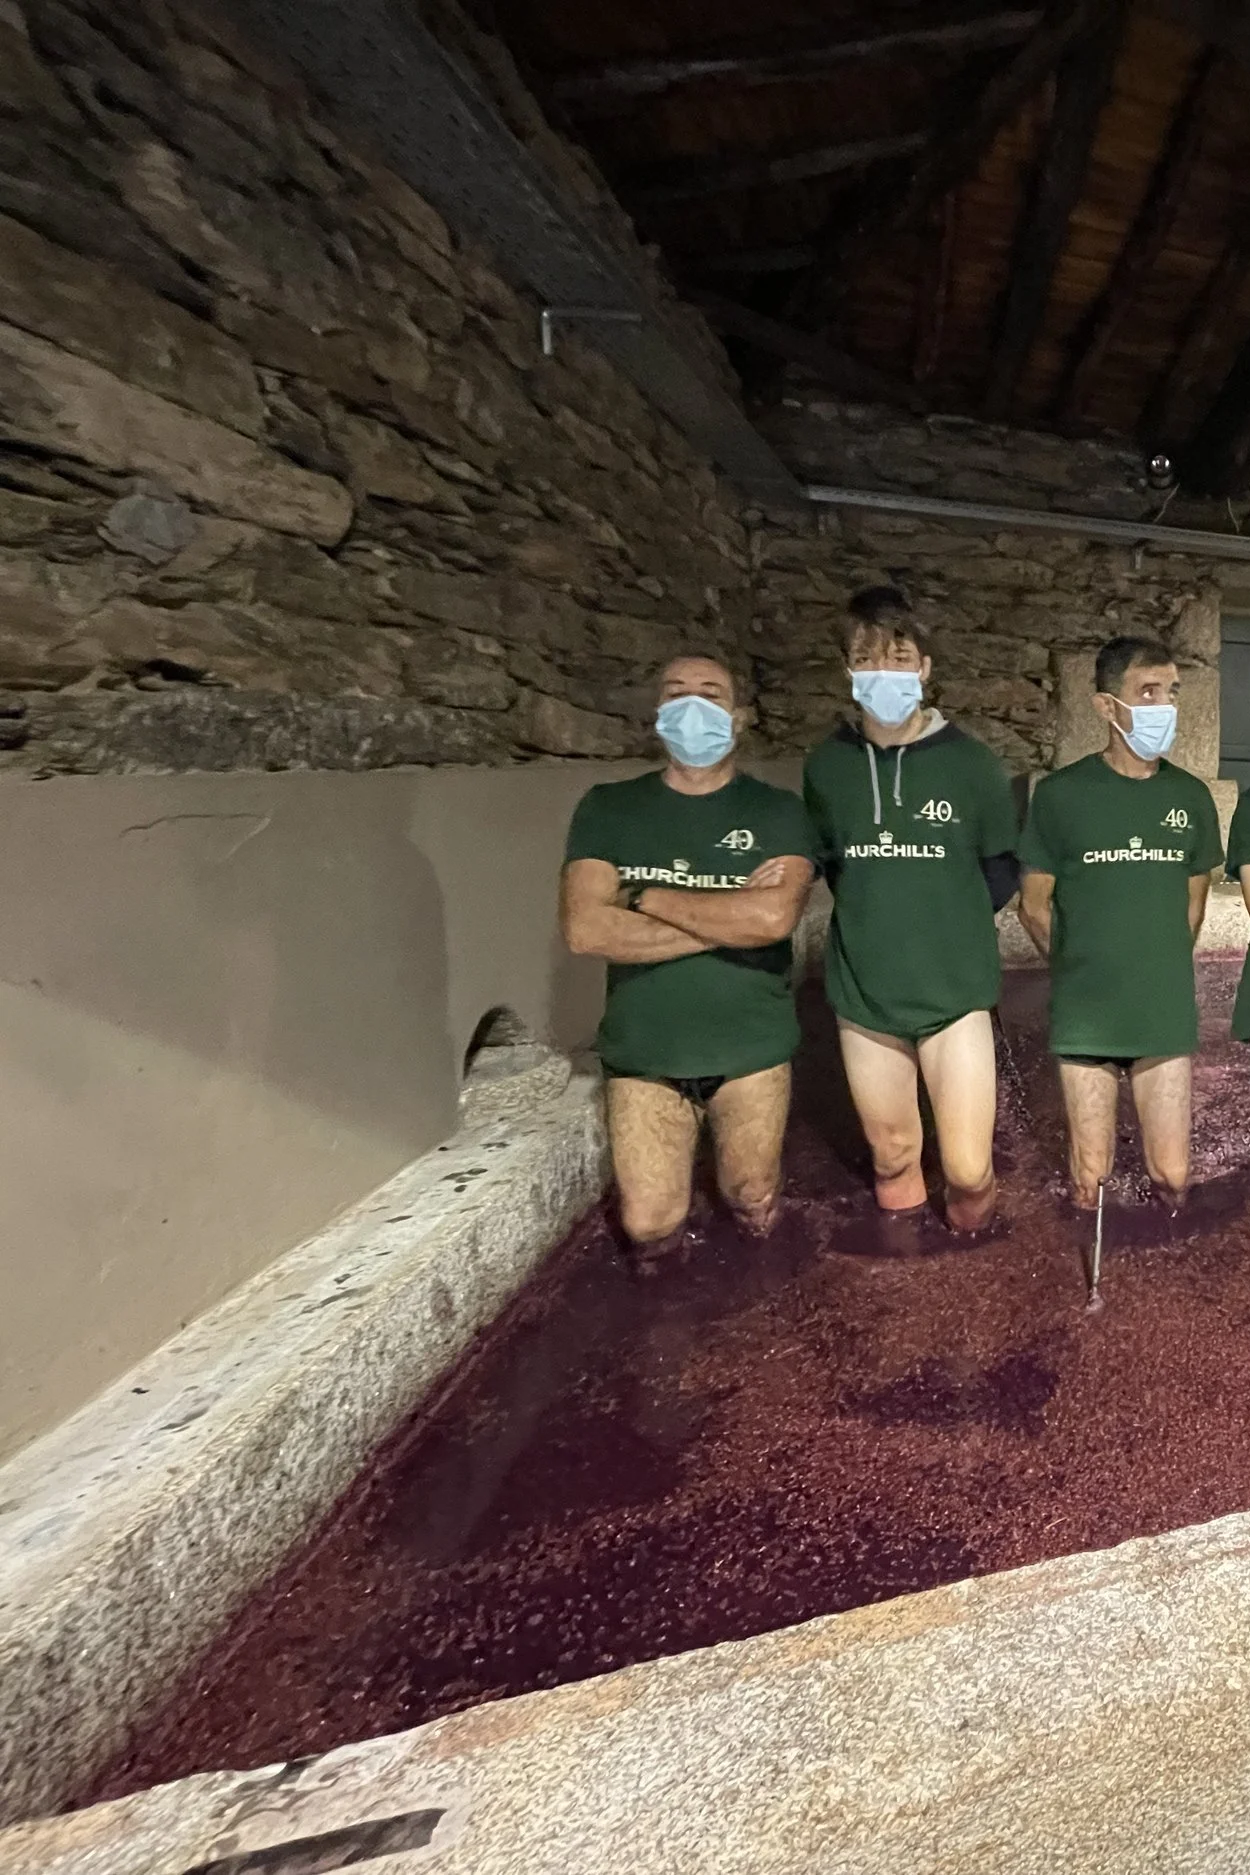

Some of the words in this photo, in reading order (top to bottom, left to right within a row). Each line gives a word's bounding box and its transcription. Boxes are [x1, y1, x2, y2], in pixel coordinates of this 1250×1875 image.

[920, 799, 952, 822] 40
[1165, 808, 1188, 828] 40
[721, 829, 754, 850] 40
[844, 844, 946, 858] HURCHILL'S
[1083, 849, 1184, 864] CHURCHILL'S
